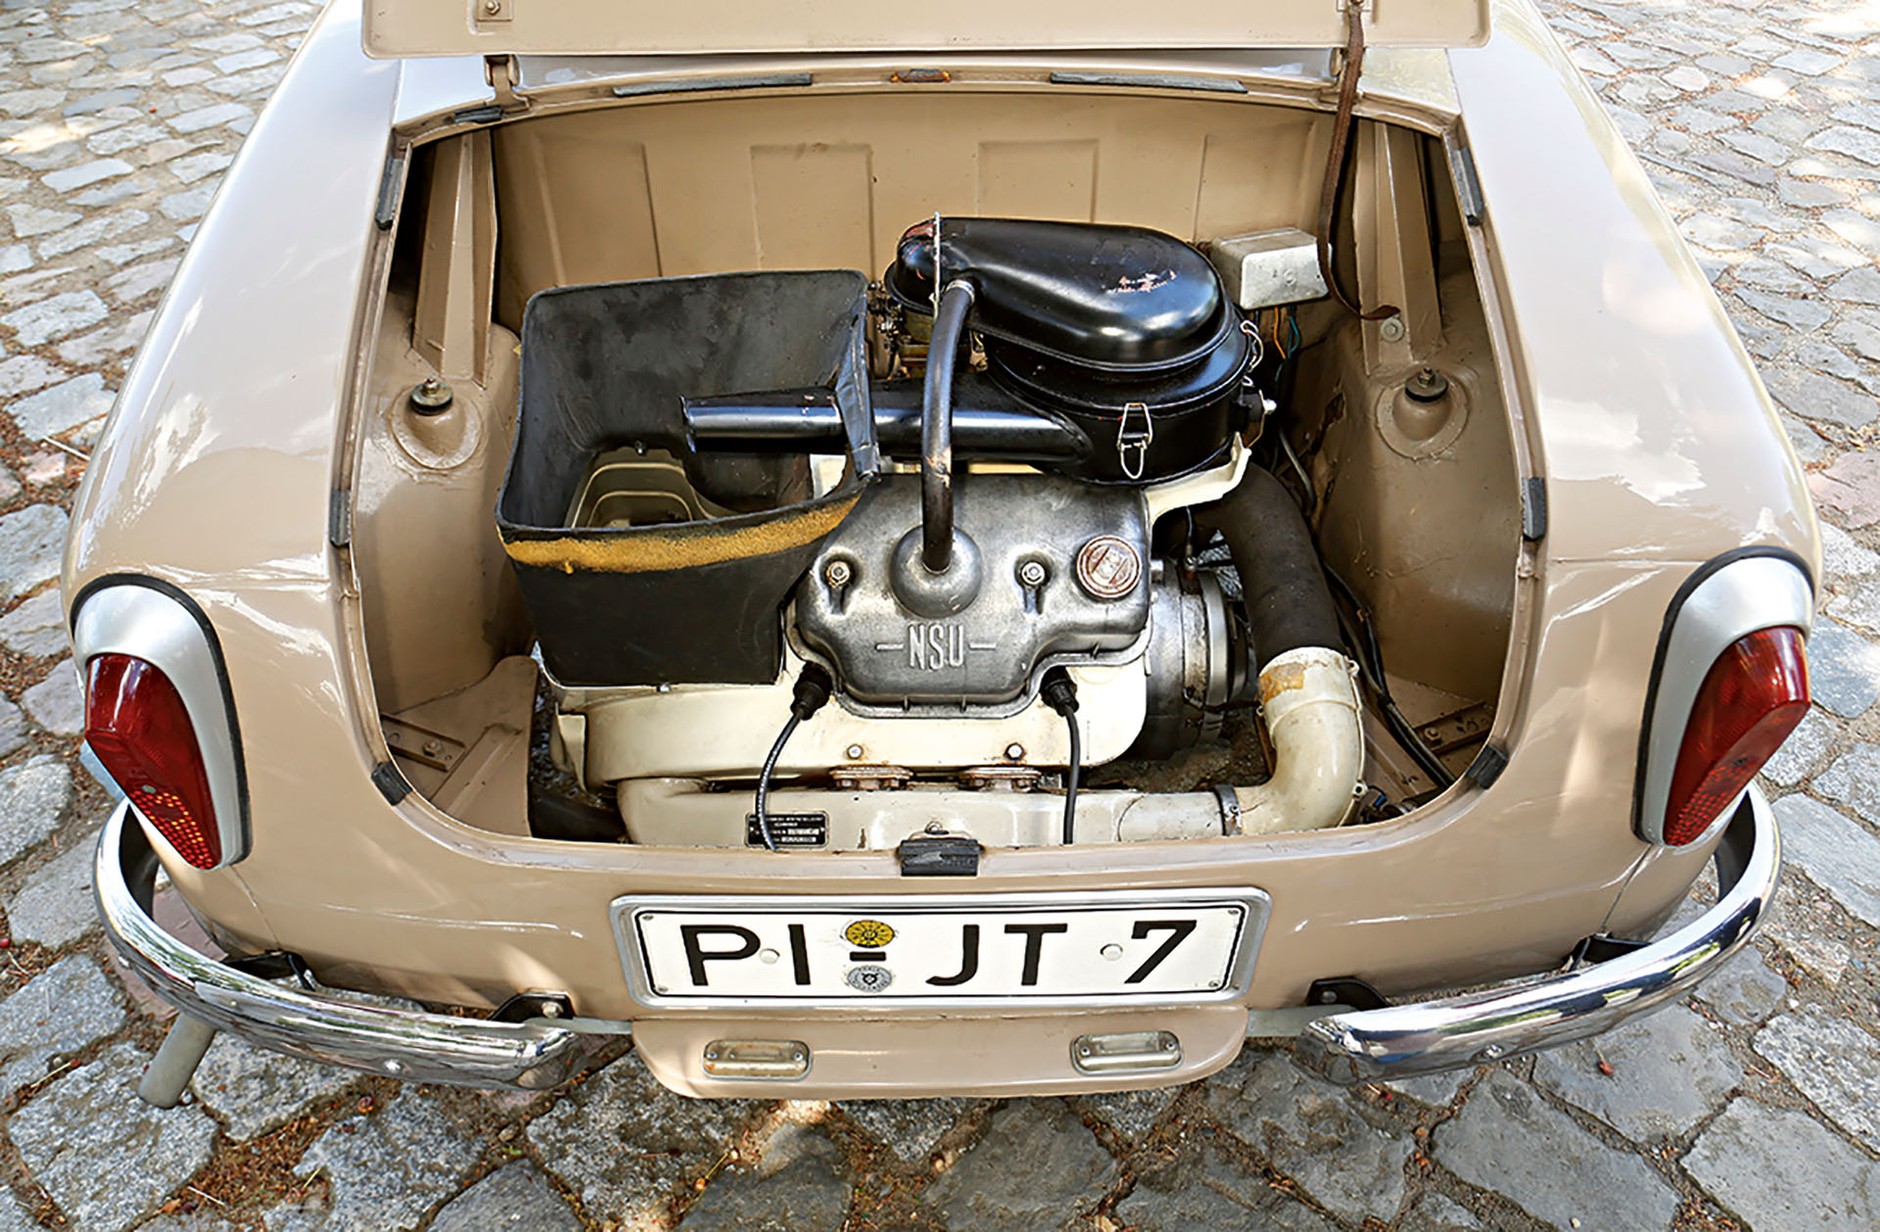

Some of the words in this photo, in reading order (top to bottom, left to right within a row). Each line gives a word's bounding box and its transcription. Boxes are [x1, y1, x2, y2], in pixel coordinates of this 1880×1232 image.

[908, 623, 965, 671] NSU
[679, 923, 811, 987] PI
[925, 922, 1069, 987] JT
[1123, 919, 1199, 985] 7
